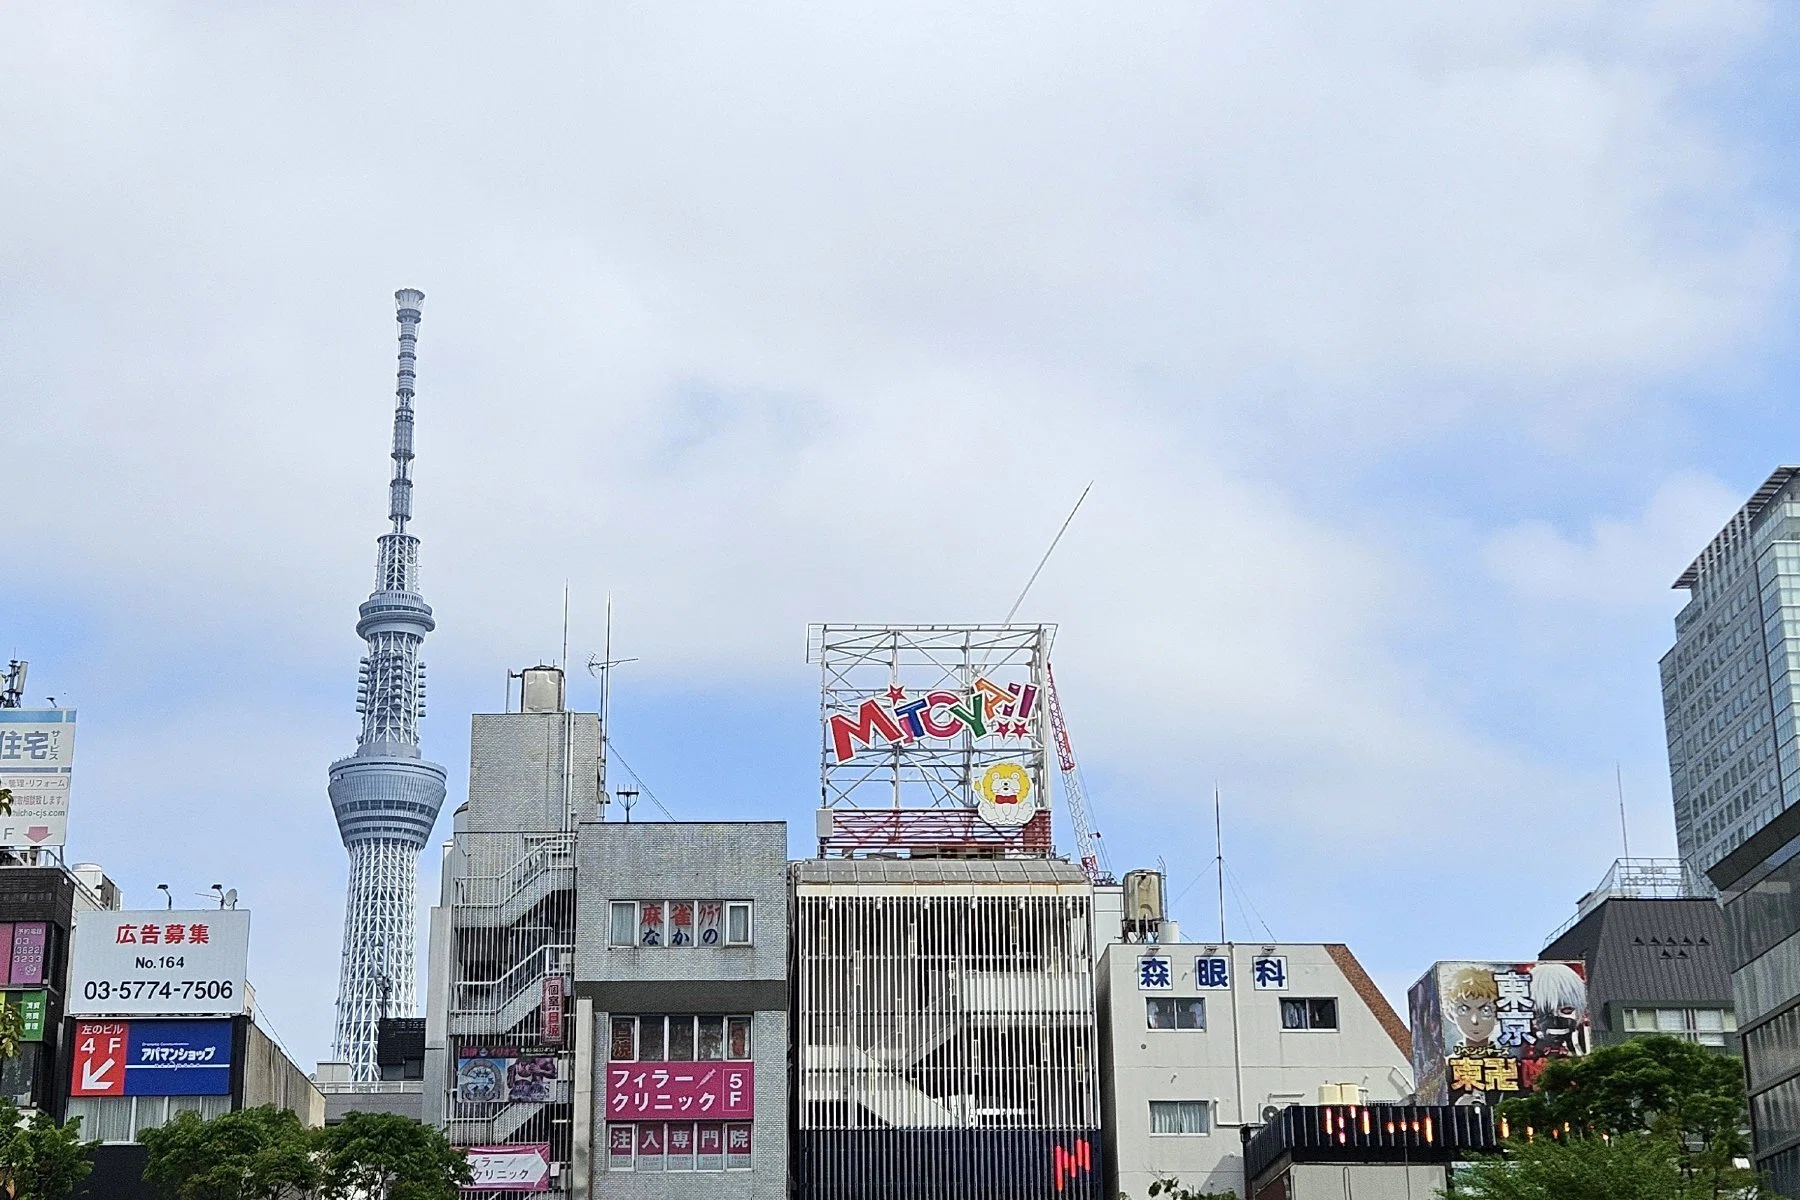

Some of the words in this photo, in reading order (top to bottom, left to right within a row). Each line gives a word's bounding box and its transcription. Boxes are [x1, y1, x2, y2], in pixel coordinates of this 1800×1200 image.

[49, 730, 60, 760] サービス
[116, 924, 209, 944] 広告募集
[642, 928, 718, 945] なかの
[135, 956, 184, 969] No.164
[1141, 958, 1285, 987] 森眼科
[84, 980, 233, 1000] 03-5774-7506
[1493, 970, 1537, 1046] 東京
[81, 1024, 123, 1034] 左のビル
[141, 1047, 216, 1061] アパマンショップ
[612, 1069, 694, 1089] フィラー
[612, 1092, 716, 1112] クリニック
[612, 1130, 749, 1149] 注入専門院
[471, 1157, 504, 1169] ィラー
